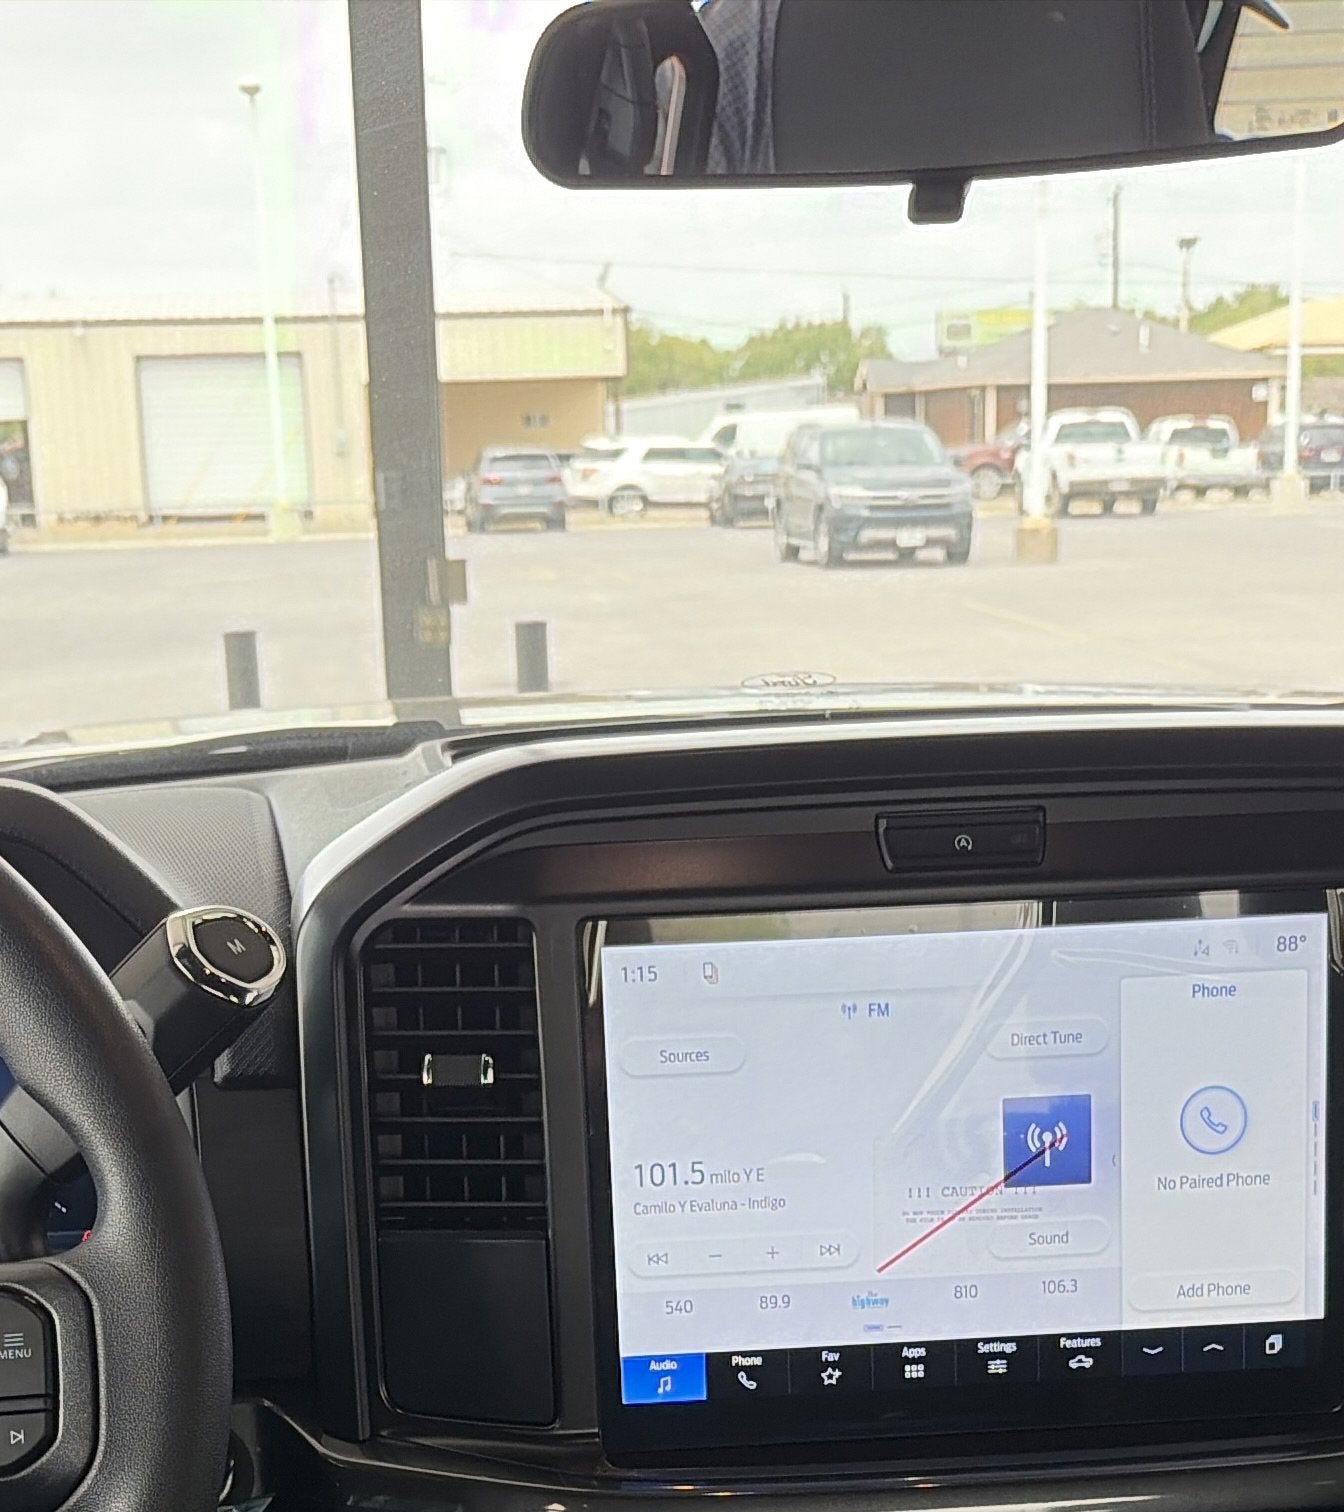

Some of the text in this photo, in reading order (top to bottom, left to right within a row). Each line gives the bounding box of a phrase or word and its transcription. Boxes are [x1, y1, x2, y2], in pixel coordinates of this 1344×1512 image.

[226, 938, 246, 955] M
[1276, 934, 1307, 952] 88°
[620, 965, 658, 983] 1:15
[1191, 983, 1237, 999] Phone
[868, 1003, 890, 1018] FM
[1010, 1030, 1083, 1047] Direct Tune
[659, 1049, 710, 1064] Sources
[634, 1161, 705, 1188] 101.5
[709, 1168, 741, 1185] milo
[1157, 1171, 1271, 1191] No Paired Phone
[940, 1185, 1003, 1198] CAUTION
[633, 1201, 677, 1216] Camilo
[678, 1200, 688, 1214] Y
[689, 1198, 738, 1213] Evaluna
[748, 1196, 786, 1212] Indigo
[1028, 1230, 1069, 1246] Sound
[953, 1278, 1078, 1300] 810 106.3
[1177, 1280, 1251, 1299] Add Phone
[665, 1295, 791, 1315] 540 89.9
[977, 1340, 1017, 1355] Settings
[1059, 1335, 1102, 1350] Features
[821, 1350, 840, 1363] Fav
[901, 1345, 927, 1359] Apps
[648, 1358, 678, 1372] Audio
[731, 1354, 763, 1368] Phone
